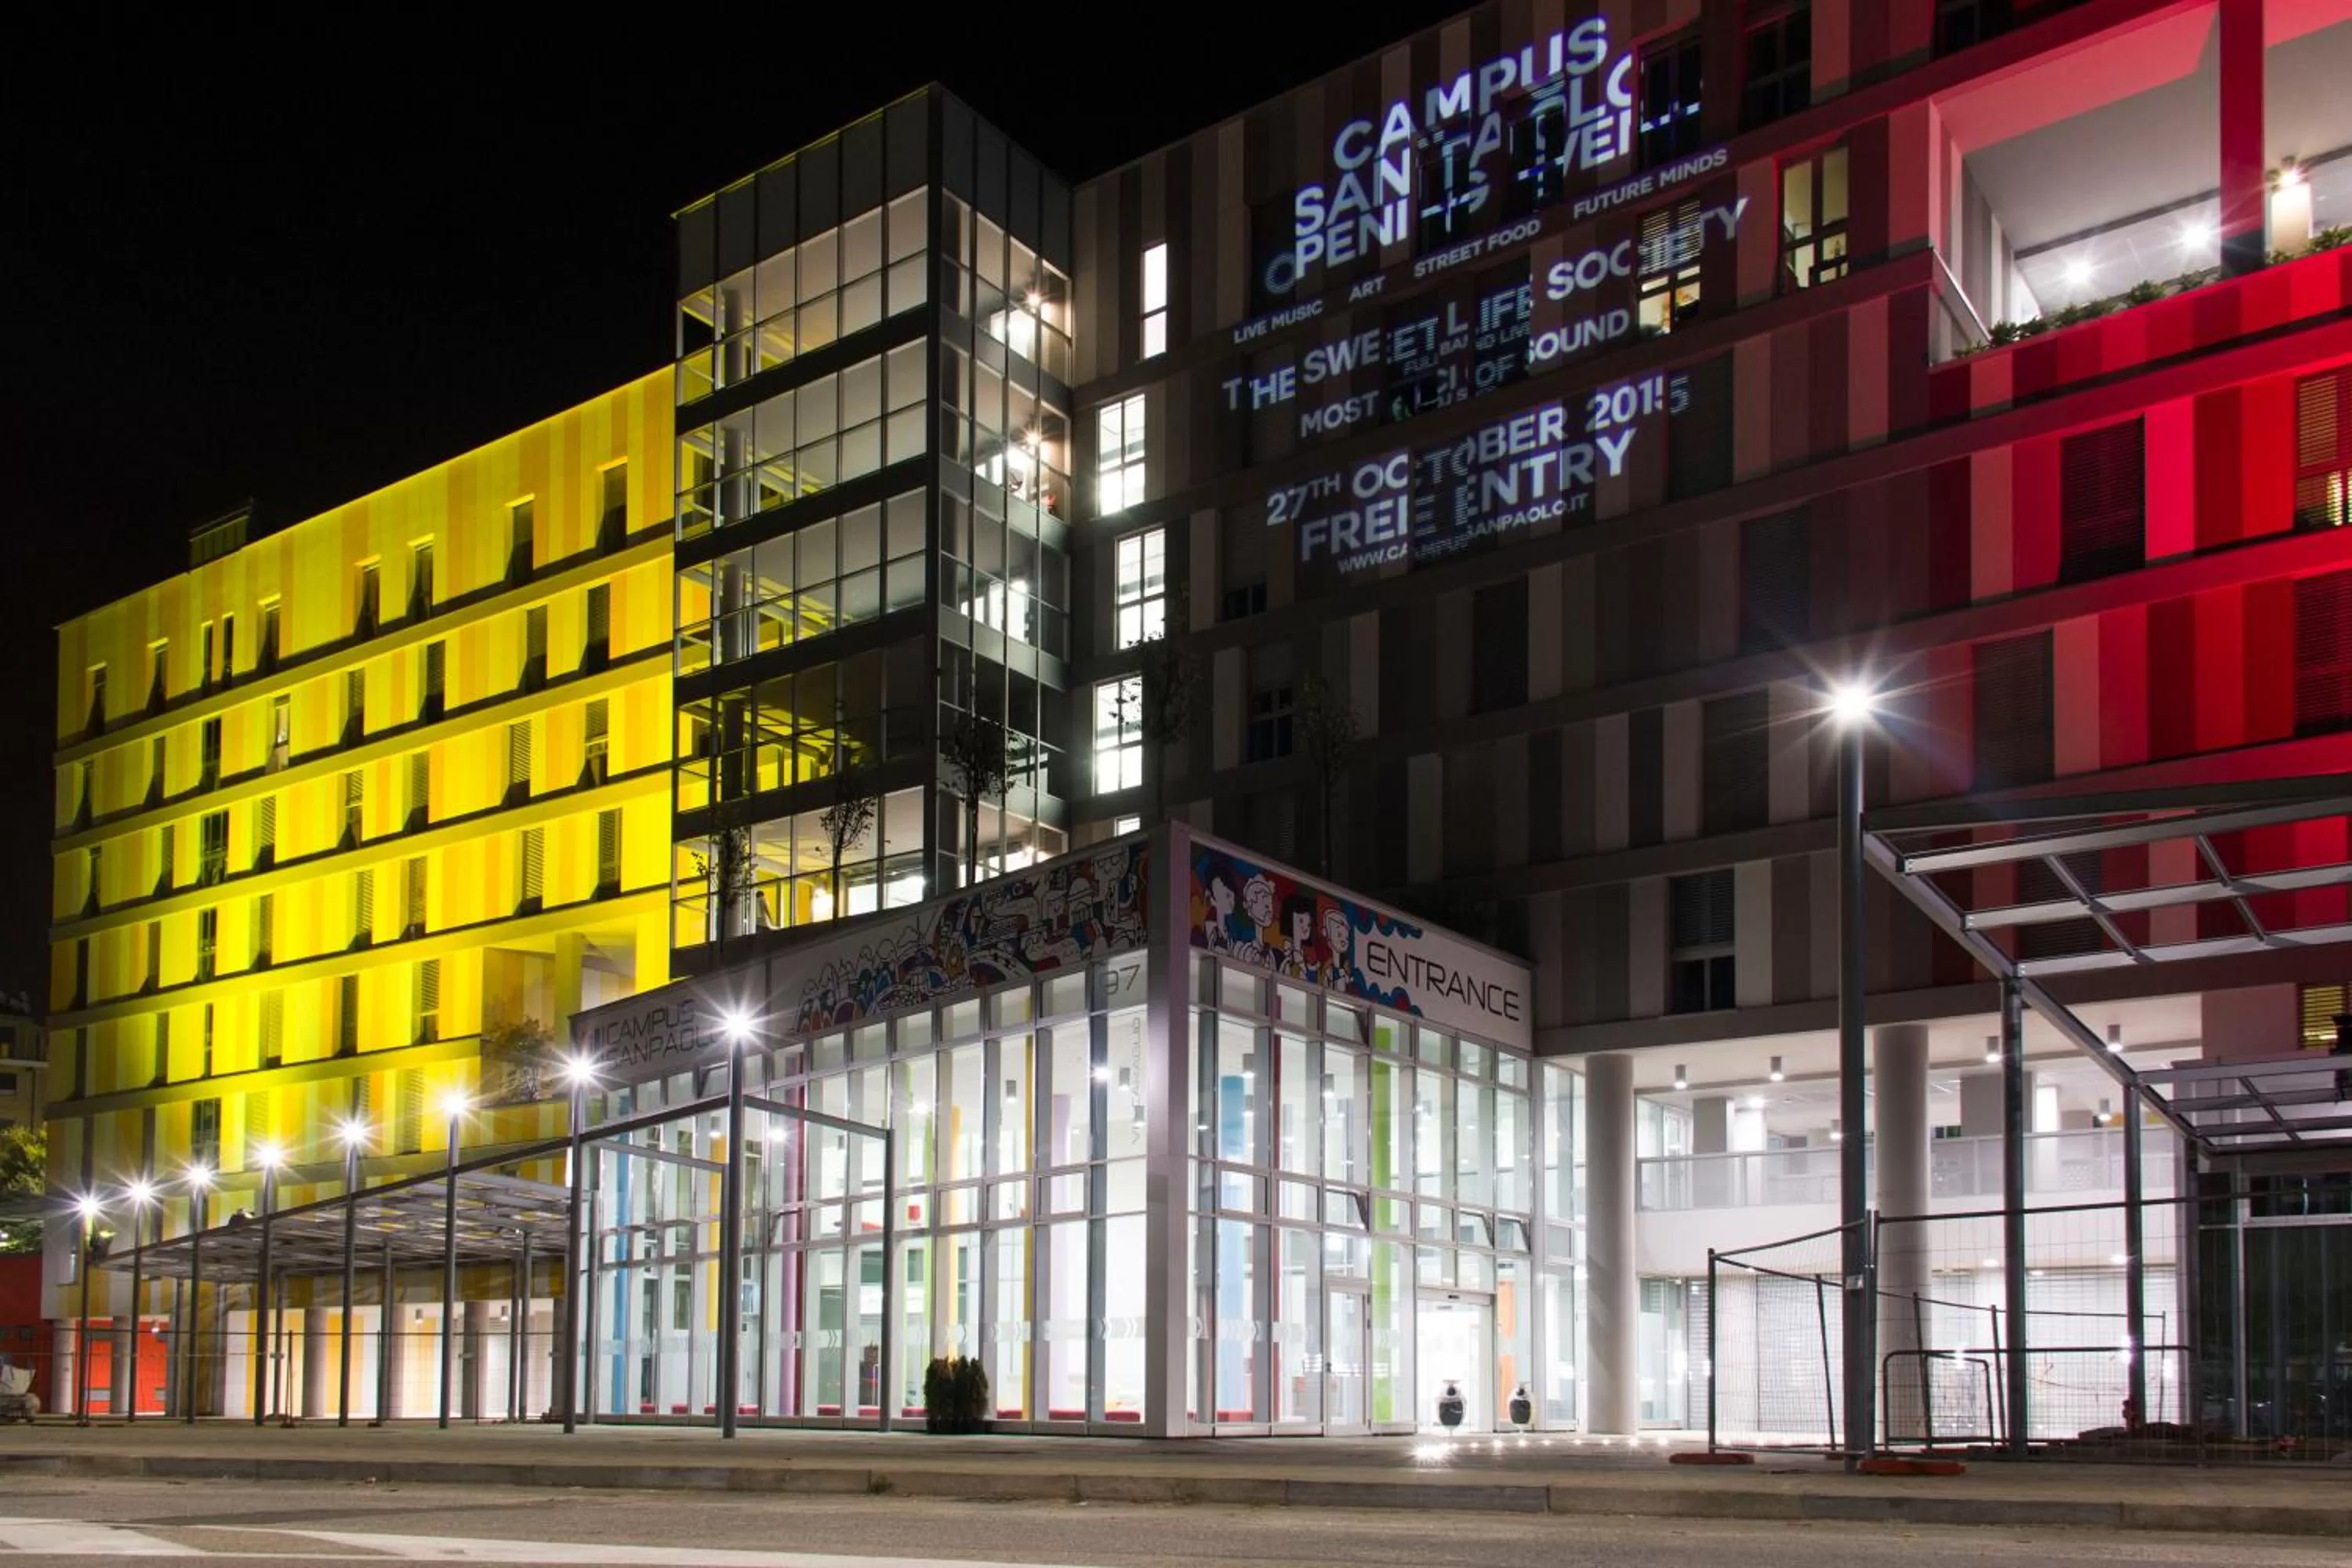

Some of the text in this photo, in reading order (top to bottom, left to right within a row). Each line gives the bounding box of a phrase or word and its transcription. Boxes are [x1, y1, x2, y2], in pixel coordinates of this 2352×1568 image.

[1334, 17, 1608, 171] CAMPUS
[1233, 148, 1729, 345] LIVE MUSIC ART STREET FOOD FUTURE MINDS
[1221, 365, 1297, 412] THE
[1300, 390, 1380, 439] MOST
[1266, 472, 1341, 528] 27TH
[1352, 405, 1569, 499] OCTOBER
[1454, 428, 1637, 527] ENTRY
[606, 998, 695, 1046] CAMPUS
[1367, 942, 1520, 1022] ENTRANCE
